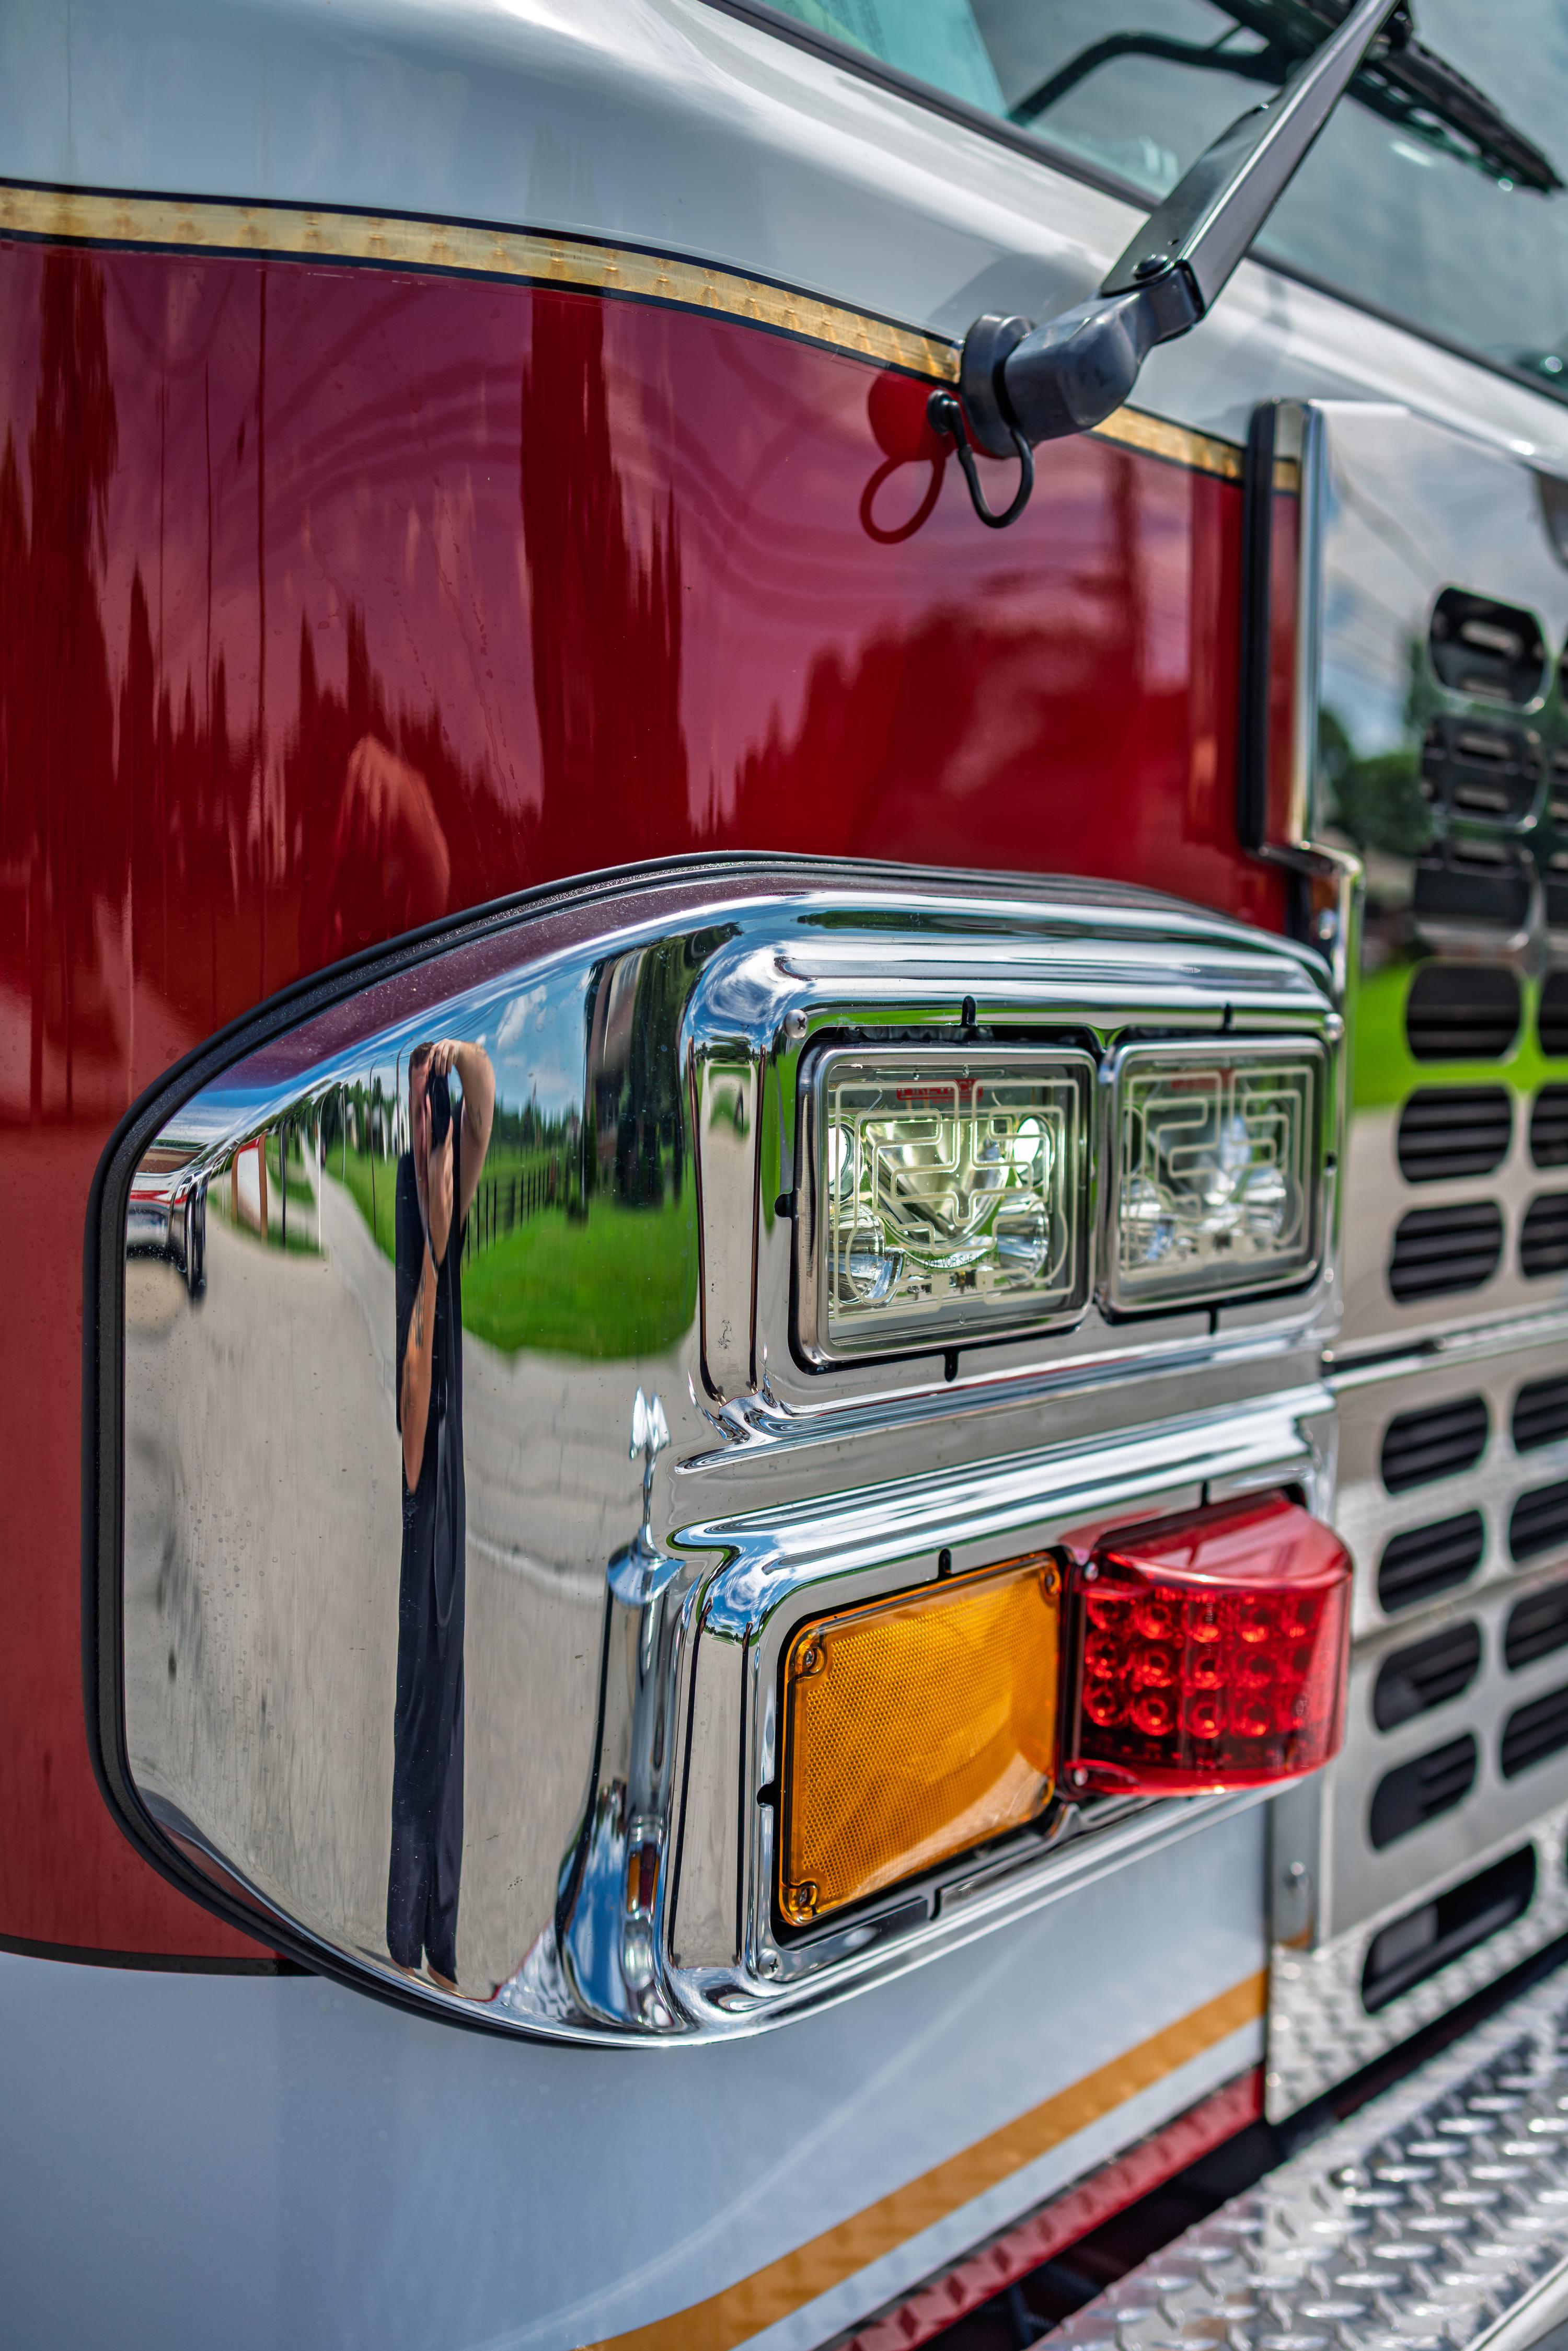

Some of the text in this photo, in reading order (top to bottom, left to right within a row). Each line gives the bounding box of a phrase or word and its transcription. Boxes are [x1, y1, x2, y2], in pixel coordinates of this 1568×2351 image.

[924, 1259, 939, 1270] DOT
[942, 1257, 957, 1267] VOR
[960, 1255, 973, 1265] SAE
